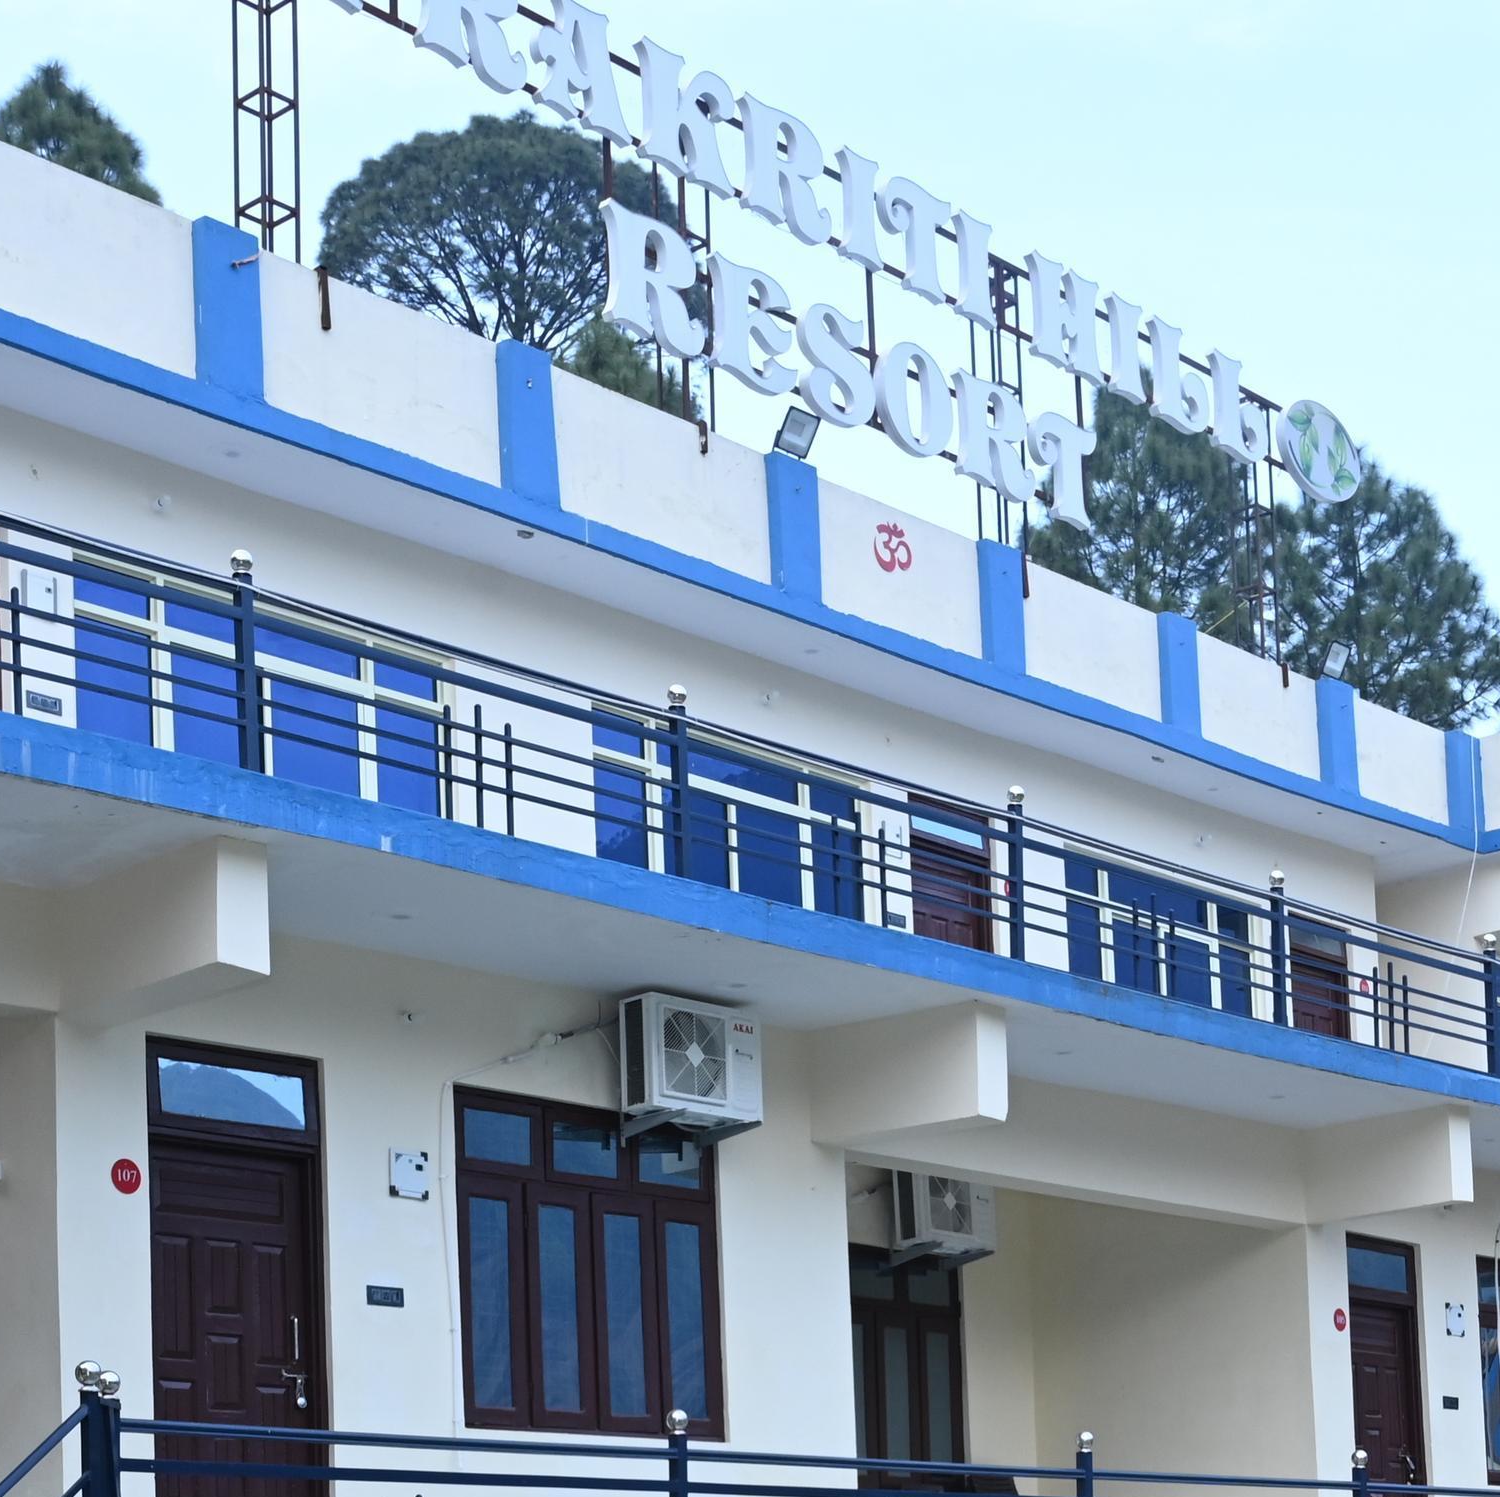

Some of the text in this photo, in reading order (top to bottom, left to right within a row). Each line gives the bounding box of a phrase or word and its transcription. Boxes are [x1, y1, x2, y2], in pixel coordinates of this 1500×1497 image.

[331, 0, 1270, 465] RAKRITI HILL
[598, 196, 1098, 531] RESORT
[732, 1022, 754, 1035] AKAI
[117, 1168, 137, 1183] 107
